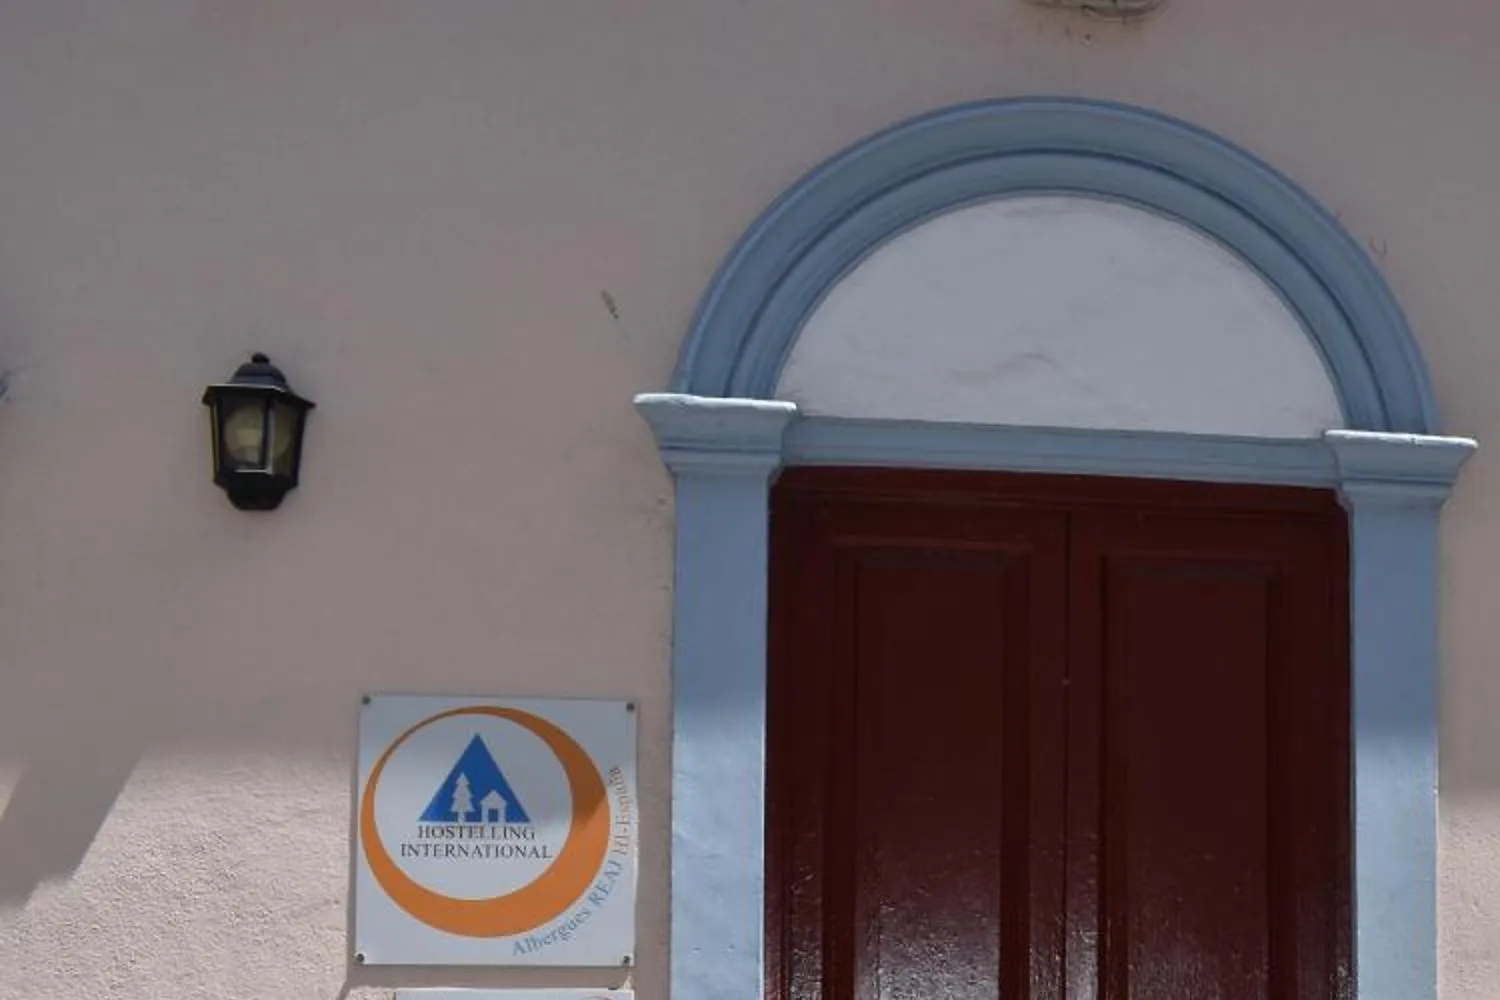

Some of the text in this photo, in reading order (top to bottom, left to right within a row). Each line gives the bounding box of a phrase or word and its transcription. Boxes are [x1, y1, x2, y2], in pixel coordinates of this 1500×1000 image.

[417, 825, 536, 841] HOSTELLING
[400, 842, 554, 859] INTERNATIONAL
[512, 908, 592, 957] Albergues
[591, 860, 624, 908] REAJ
